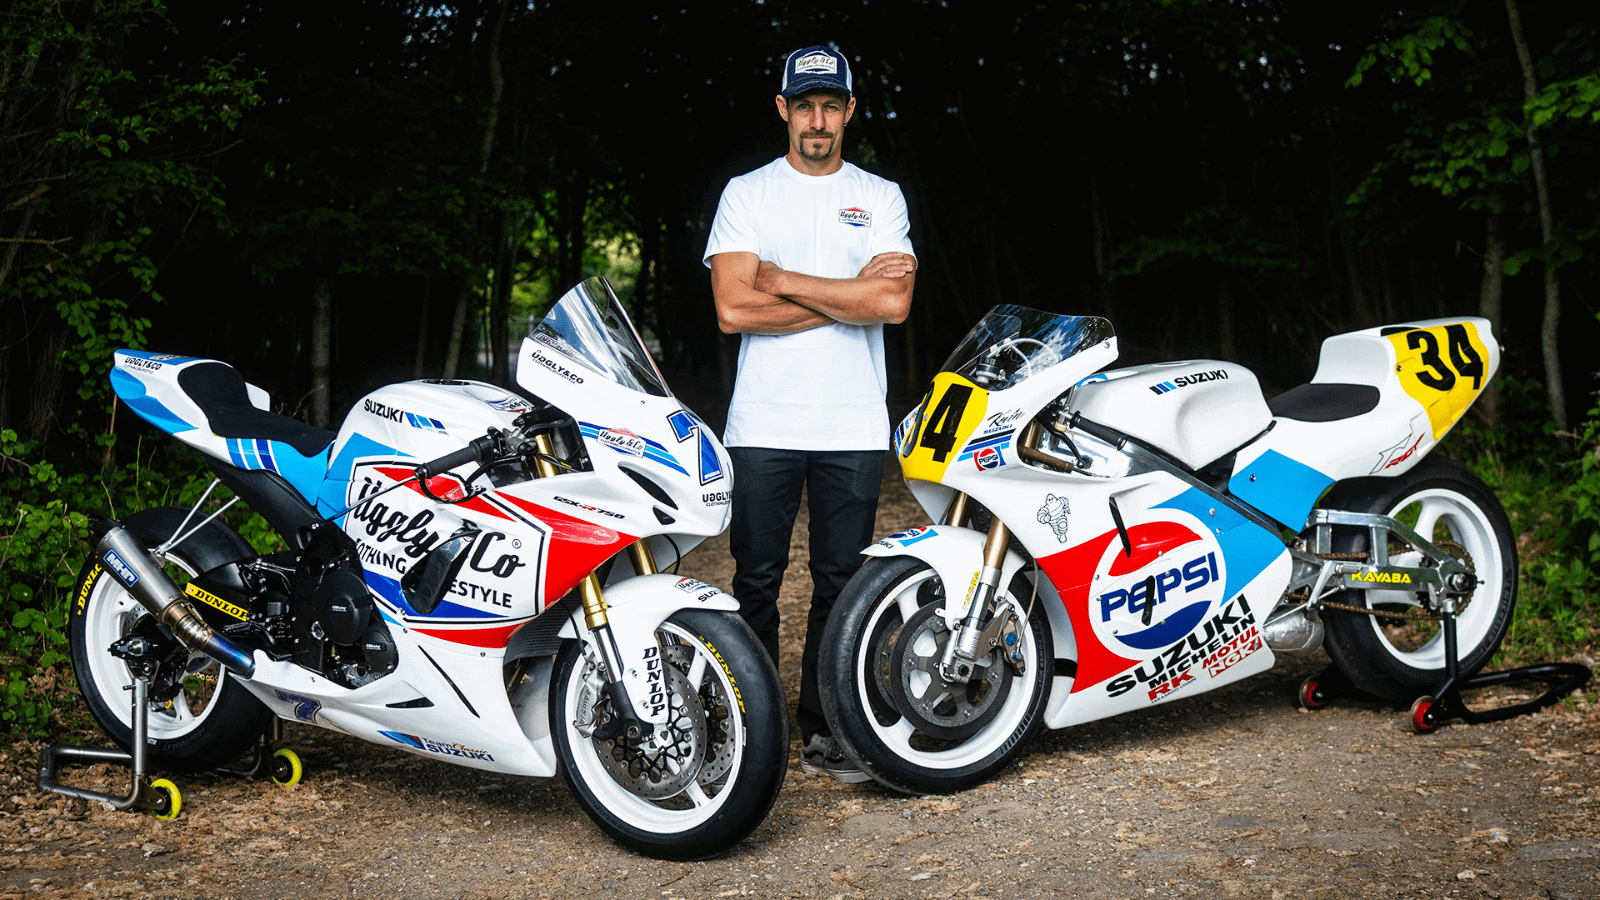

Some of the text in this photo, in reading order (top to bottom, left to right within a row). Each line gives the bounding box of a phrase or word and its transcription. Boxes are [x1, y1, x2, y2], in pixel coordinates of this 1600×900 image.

[1406, 324, 1484, 391] 34
[1174, 370, 1229, 388] SUZUKI
[363, 399, 404, 423] SUZUKI
[983, 424, 1013, 434] SUZUKI
[666, 409, 724, 486] 7
[979, 454, 999, 464] PEPSI
[448, 579, 512, 608] ESTYLE
[1100, 551, 1219, 622] PEPSI
[1351, 572, 1411, 584] KAYABA
[1106, 594, 1251, 697] SUZUKI
[1148, 613, 1255, 689] MICHELIN
[1202, 626, 1259, 669] MOTUL
[1208, 636, 1262, 678] NGK
[643, 646, 666, 717] DUNLOP
[705, 640, 746, 713] DUNLOP
[1147, 668, 1194, 701] RK
[580, 689, 591, 724] brembo
[421, 737, 488, 754] Team Classic
[426, 743, 495, 762] SUZUKI
